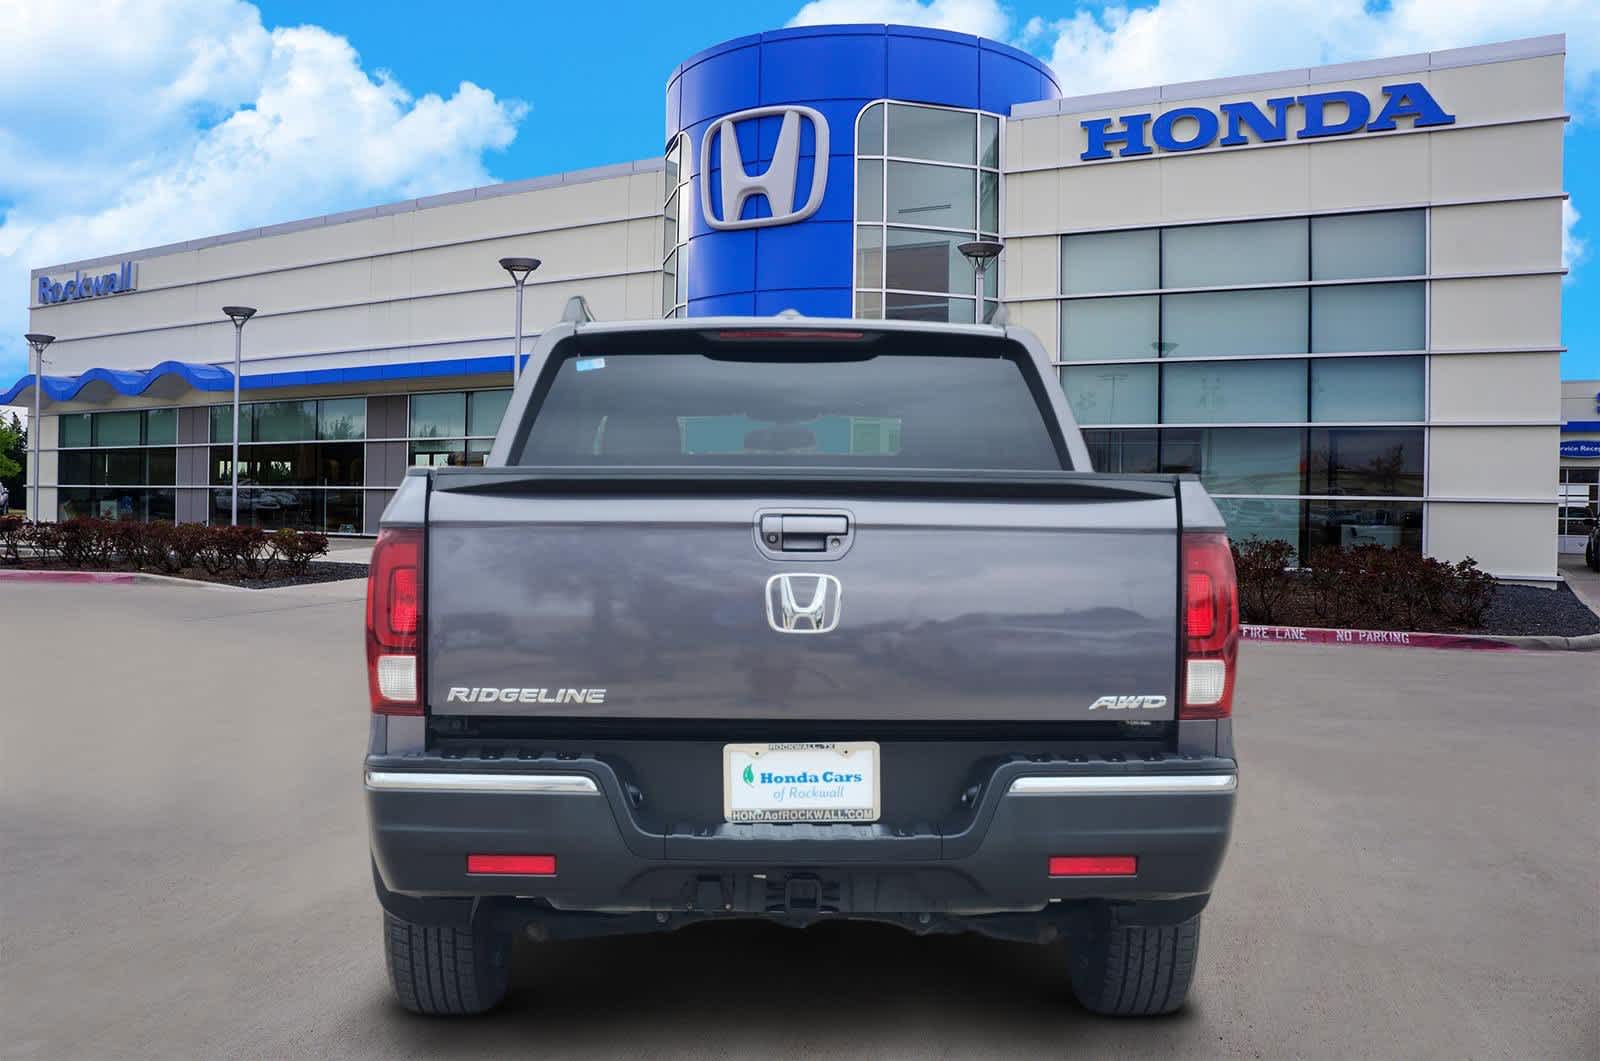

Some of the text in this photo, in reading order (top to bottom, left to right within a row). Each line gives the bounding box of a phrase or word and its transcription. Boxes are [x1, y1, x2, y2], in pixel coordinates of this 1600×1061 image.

[1080, 82, 1456, 161] HONDA
[38, 260, 133, 304] Rockwall
[1242, 627, 1409, 644] FIRE LANE NO PARKING
[447, 687, 607, 704] RIDGELINE
[1088, 695, 1167, 710] AWD
[760, 771, 863, 784] Honda Cars
[773, 785, 845, 801] of Rockwall
